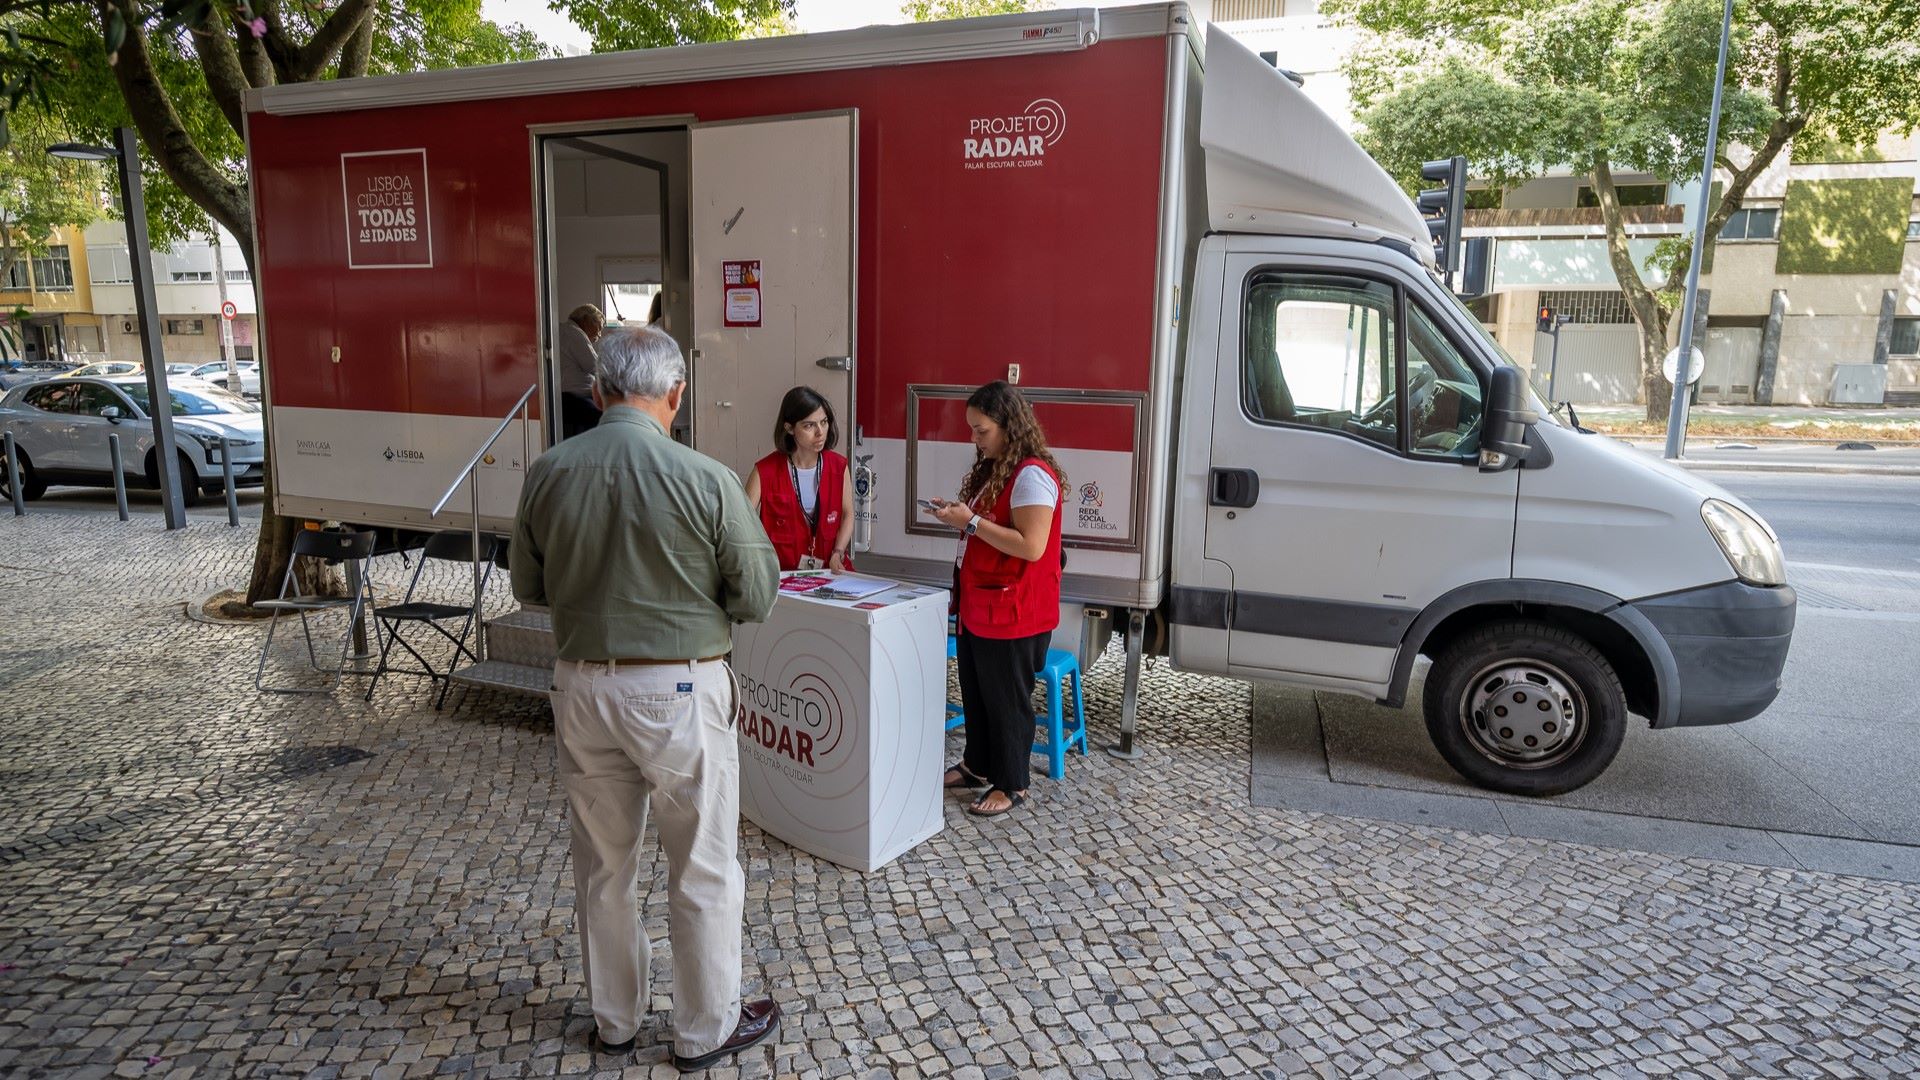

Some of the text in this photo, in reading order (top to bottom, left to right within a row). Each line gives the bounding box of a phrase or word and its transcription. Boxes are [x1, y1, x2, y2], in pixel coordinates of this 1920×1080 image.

[970, 115, 1051, 135] PROJETO
[963, 135, 1044, 159] RADAR
[964, 159, 1043, 170] FALAR ESCUTAR CUIDAR
[367, 175, 412, 191] LISBOA
[358, 191, 414, 207] CIDADE DE
[358, 207, 416, 228] TODAS
[360, 228, 417, 242] AS IDADES
[396, 450, 424, 460] LISBOA
[1079, 514, 1106, 523] SOCIAL
[1091, 522, 1117, 530] LISBOA
[741, 673, 822, 728] PROJETO
[738, 702, 815, 768] RADAR
[783, 765, 814, 785] CUIDAR
